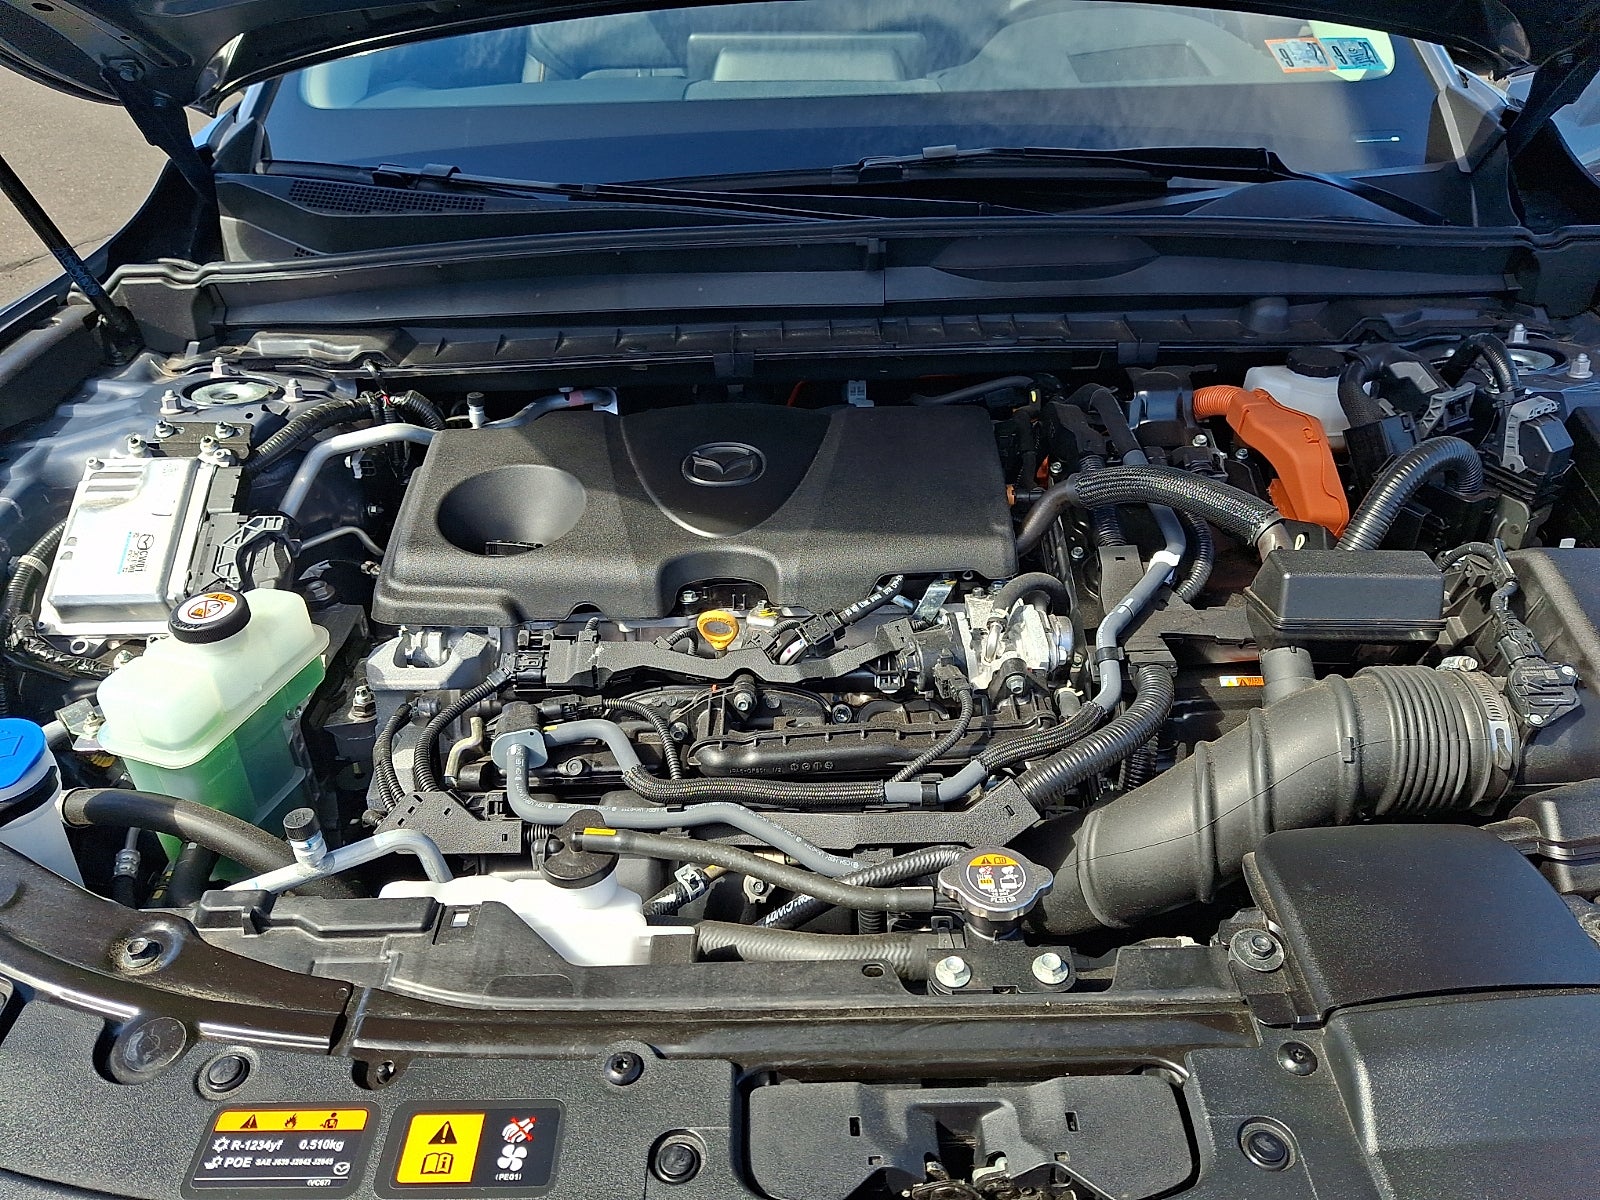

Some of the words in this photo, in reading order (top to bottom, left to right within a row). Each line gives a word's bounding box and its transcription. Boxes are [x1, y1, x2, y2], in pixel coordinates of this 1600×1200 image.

[231, 1139, 283, 1151] R-1234yf
[298, 1139, 345, 1152] 0.510kg
[224, 1157, 252, 1168] POE
[255, 1158, 272, 1166] SAE
[495, 1173, 522, 1181] (PE01)
